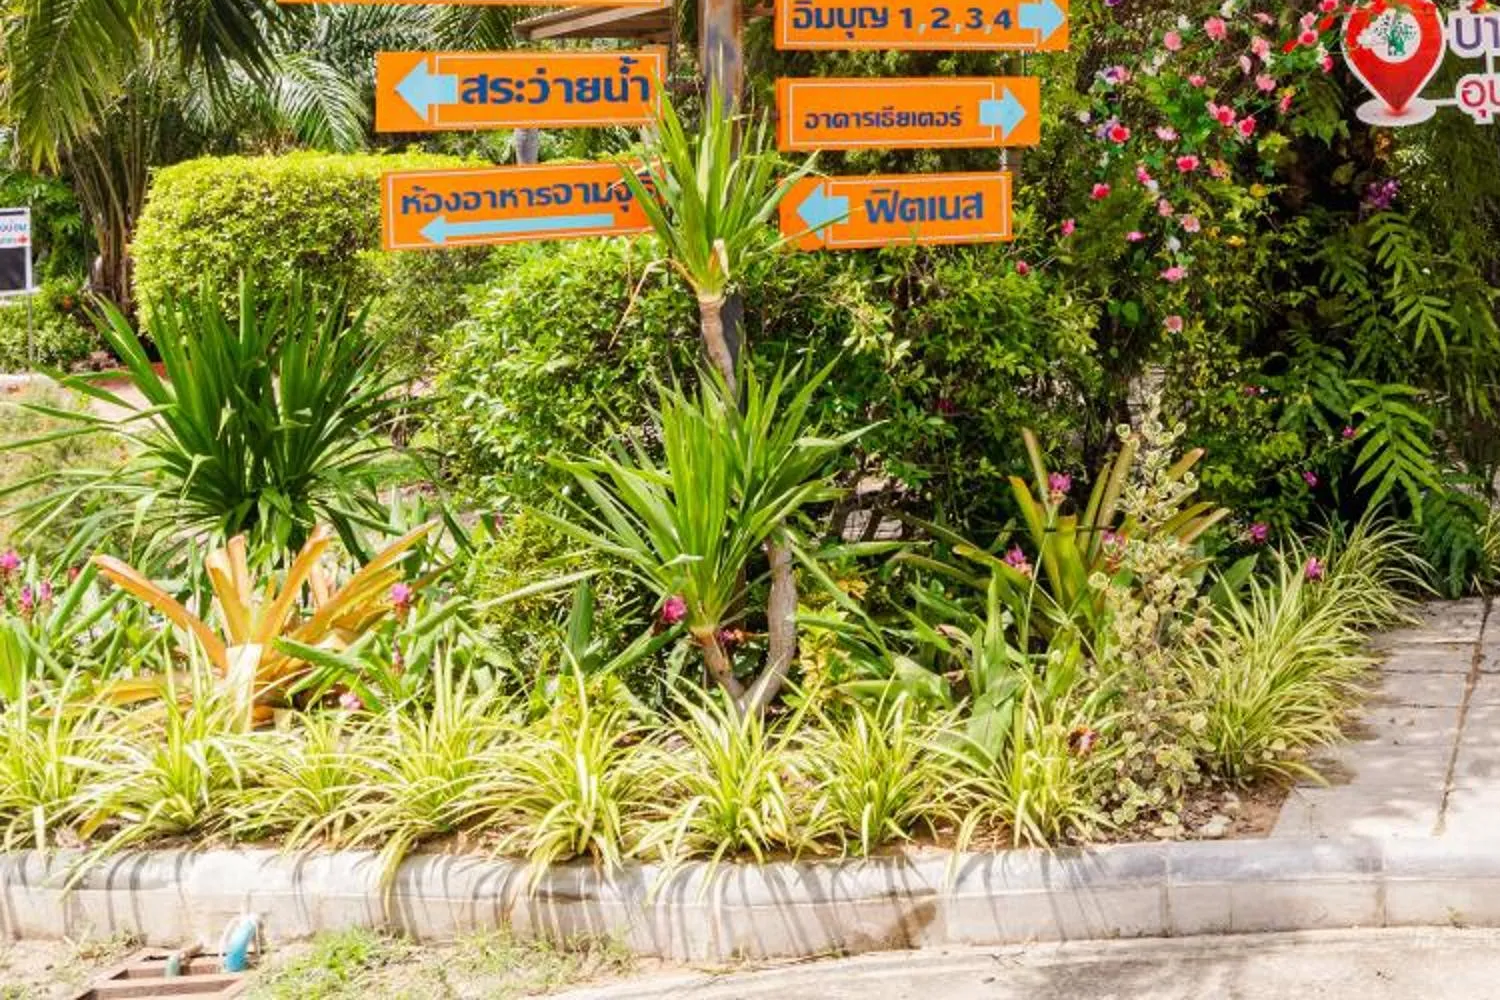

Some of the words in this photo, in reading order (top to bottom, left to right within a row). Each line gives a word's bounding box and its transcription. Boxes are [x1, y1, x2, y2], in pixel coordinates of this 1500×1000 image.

[461, 56, 650, 104] สระว่ายน้ำ
[864, 188, 984, 224] ฟิตเนส
